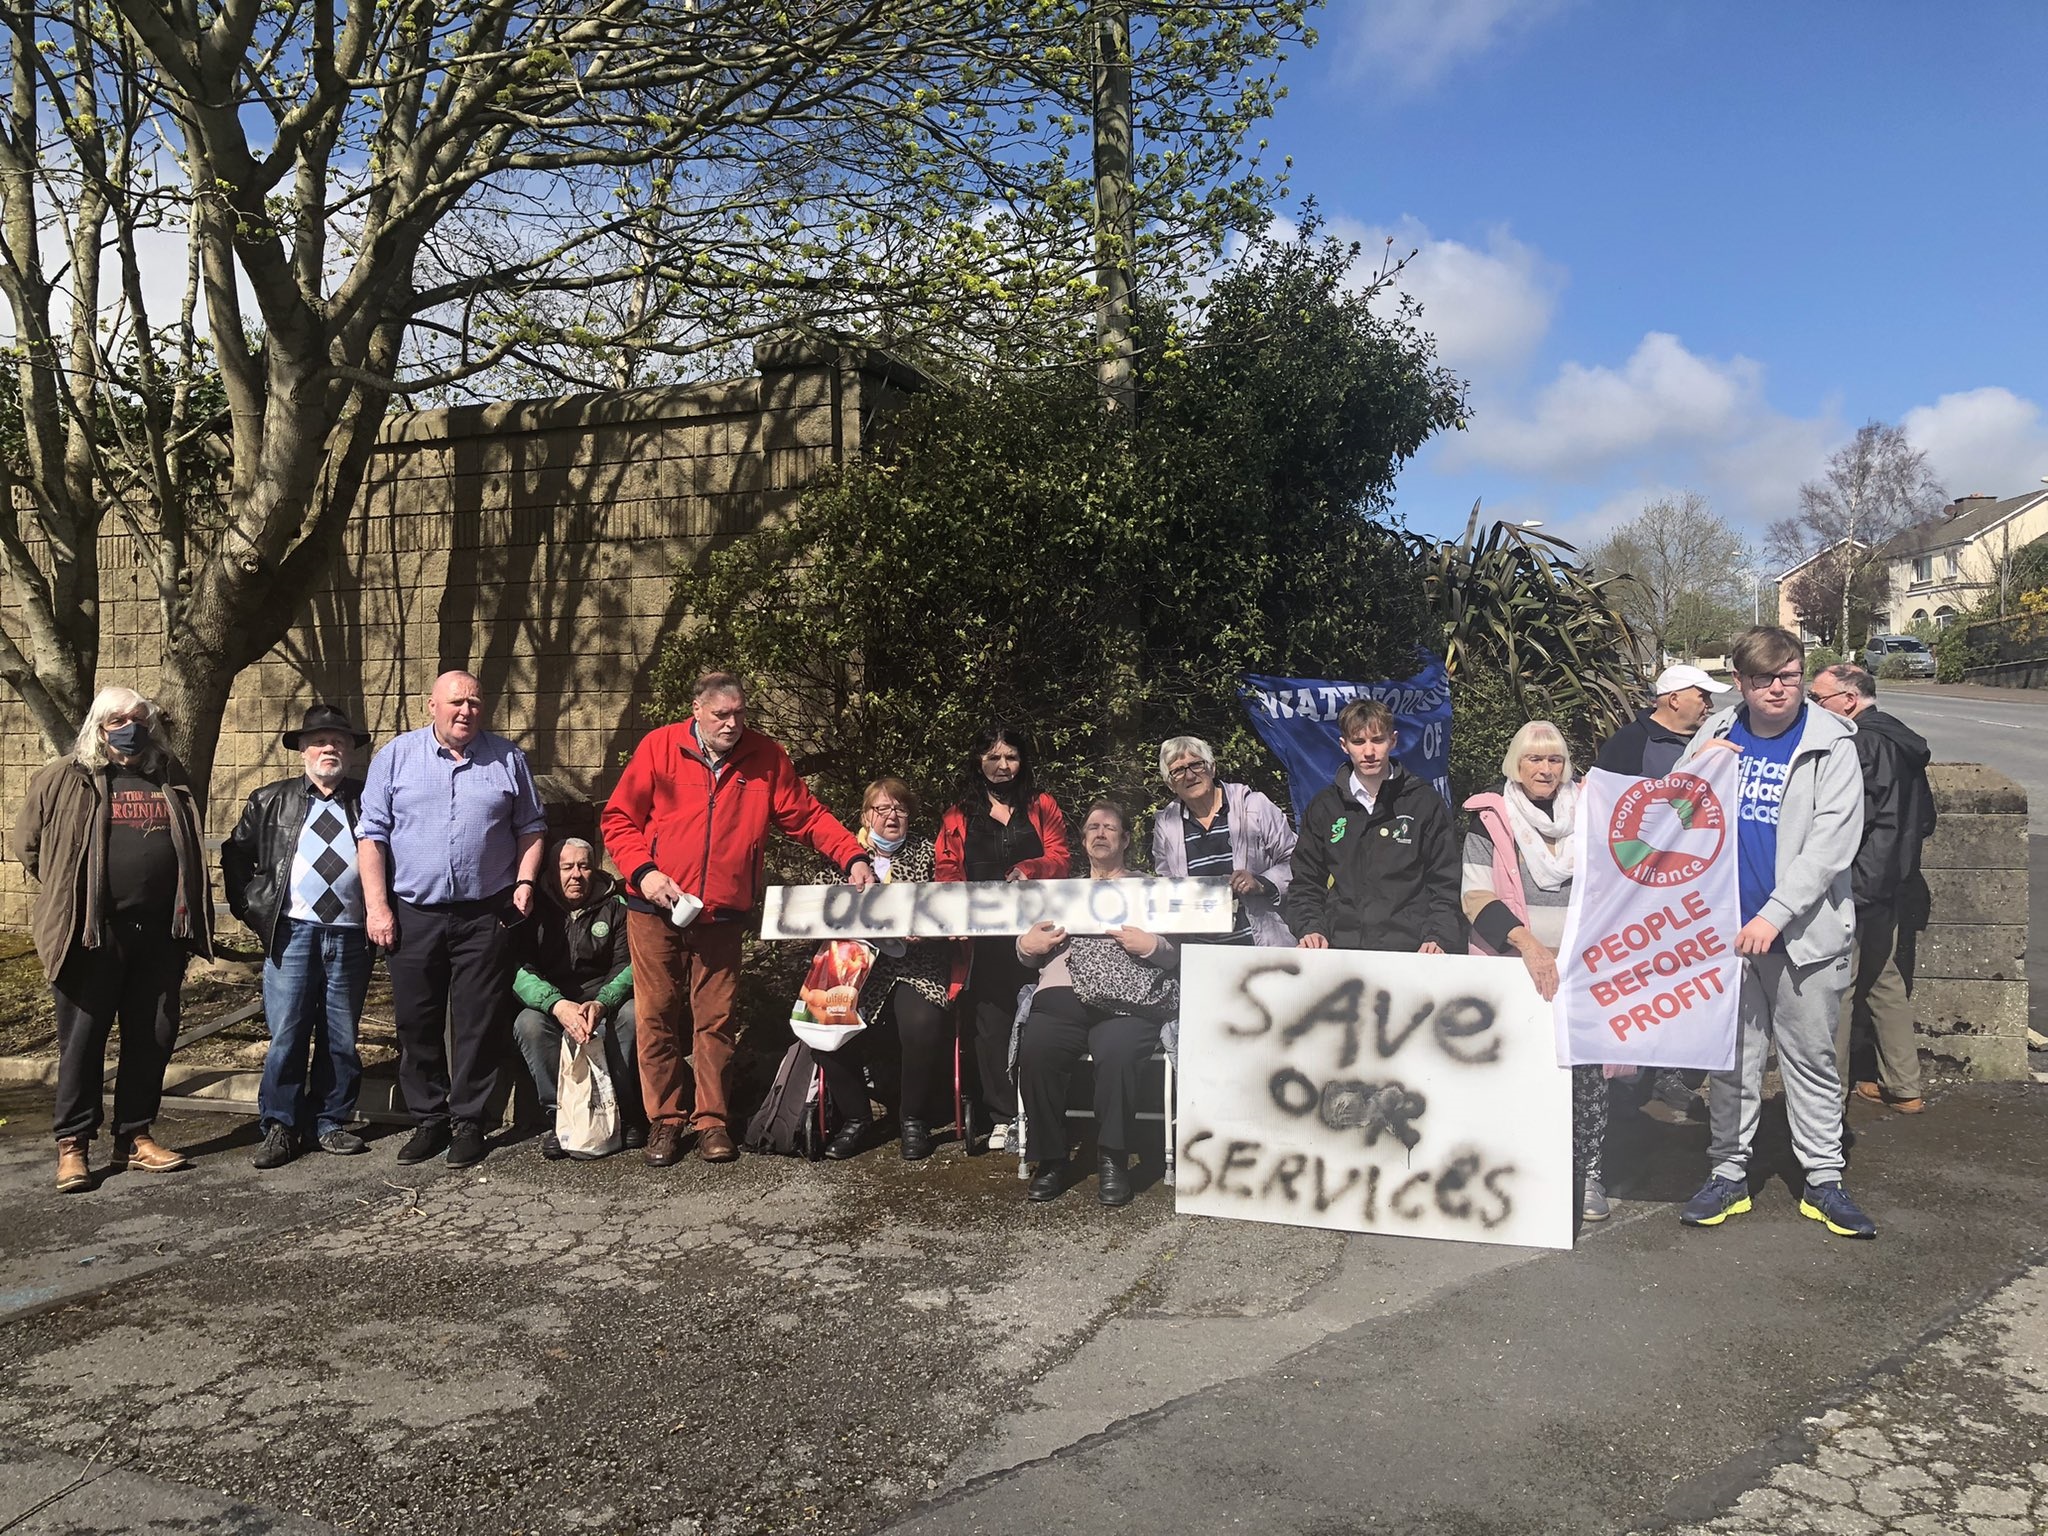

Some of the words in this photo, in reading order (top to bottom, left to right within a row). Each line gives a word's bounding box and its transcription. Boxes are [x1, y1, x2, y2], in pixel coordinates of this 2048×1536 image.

[1423, 722, 1442, 760] OF
[1738, 755, 1788, 780] didas
[1612, 789, 1643, 839] People
[1643, 777, 1694, 793] Before
[1694, 783, 1720, 825] Profit
[1738, 776, 1782, 803] idas
[1631, 860, 1704, 884] Alliance
[777, 880, 1046, 935] LOCKED
[1582, 890, 1711, 973] PEOPLE
[1589, 926, 1727, 1007] BEFORE
[1608, 967, 1724, 1042] PROFIT
[1268, 1066, 1428, 1150] OR
